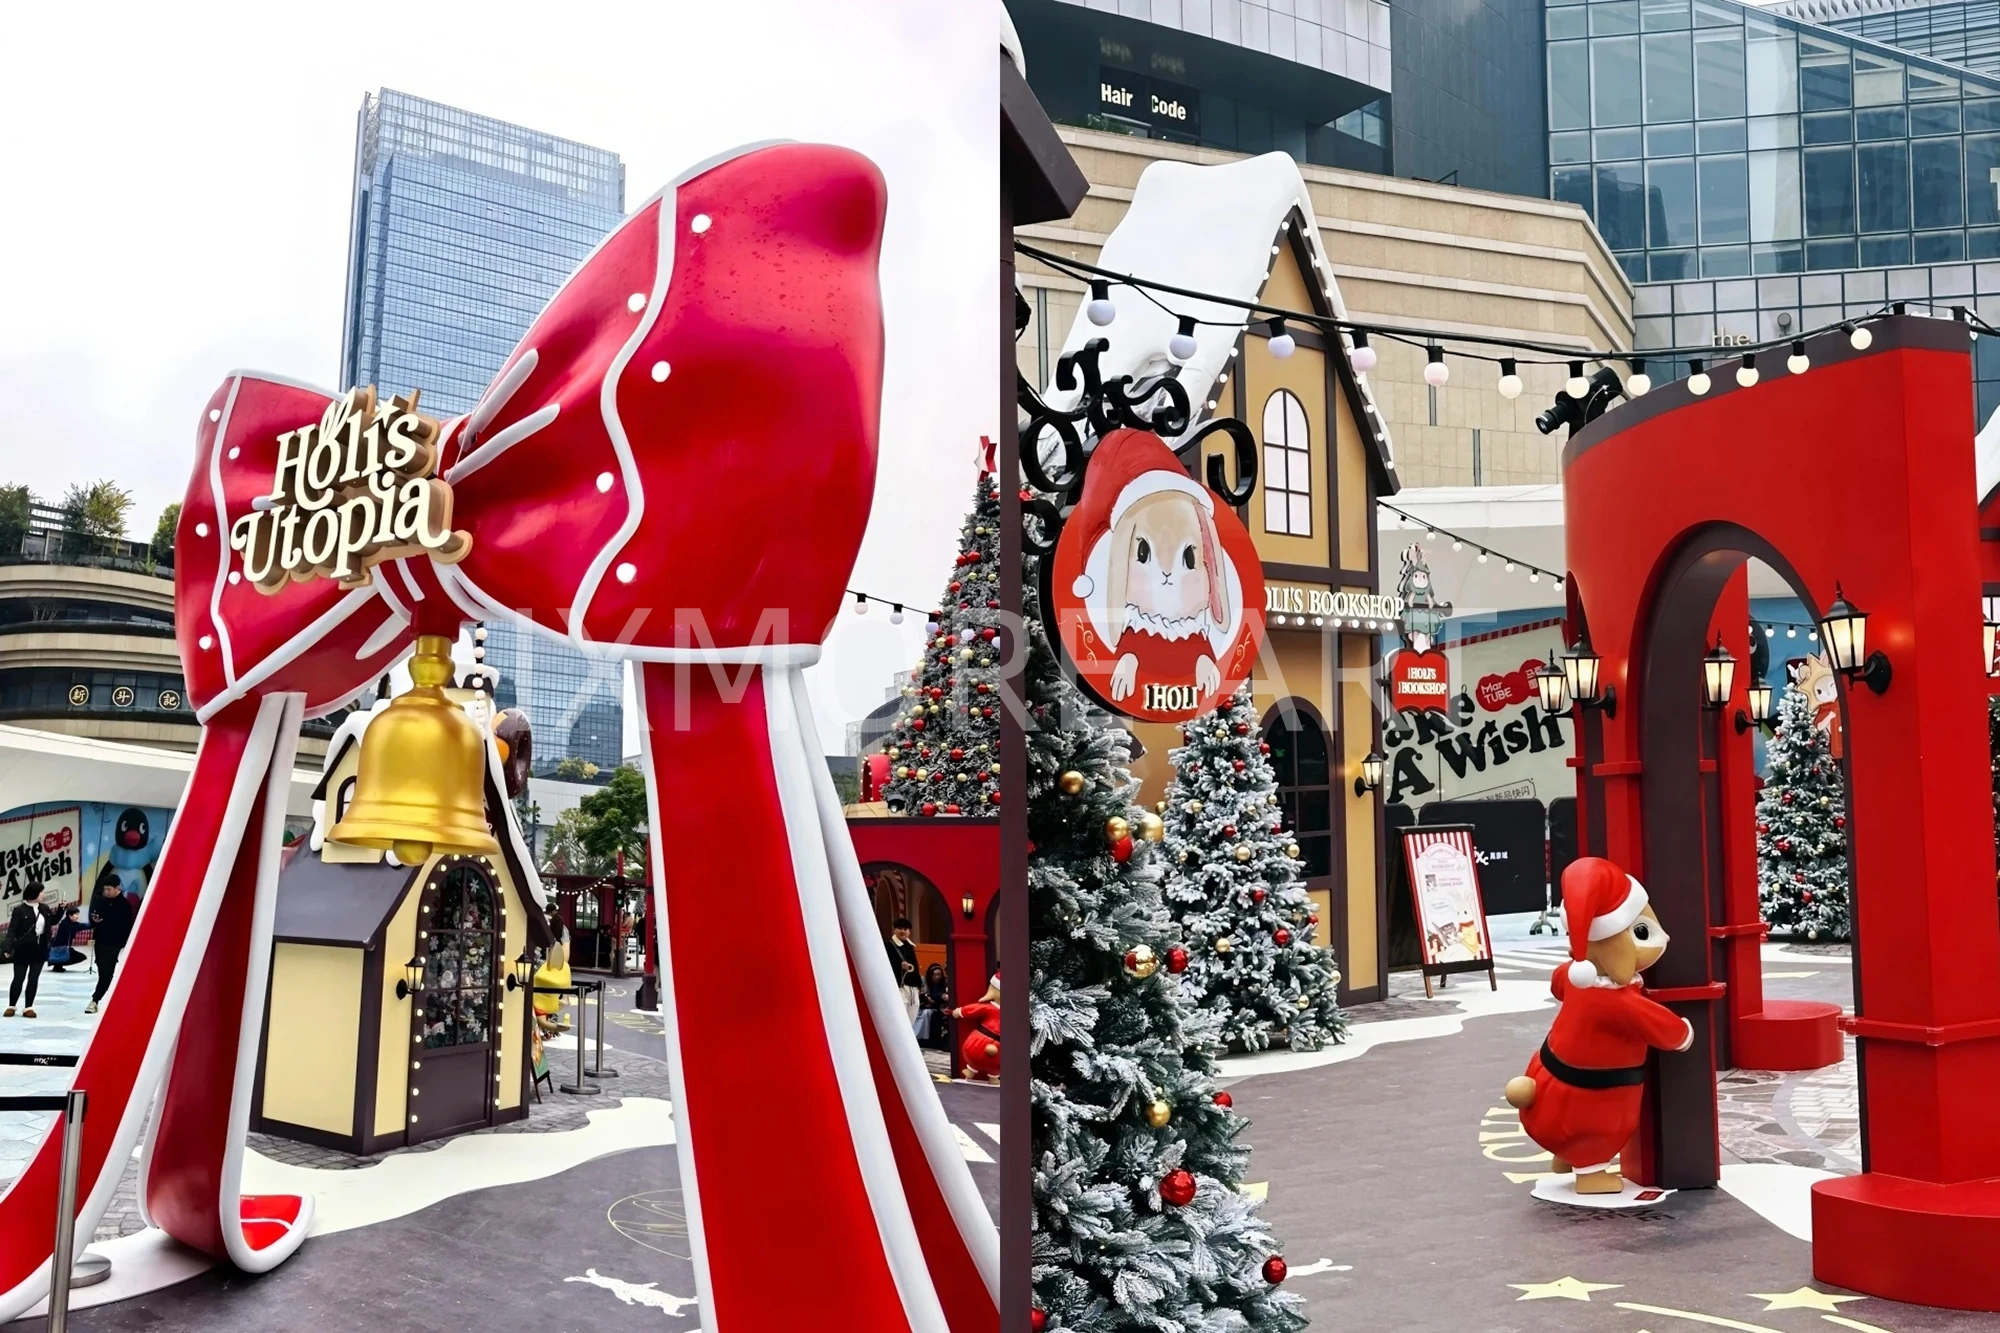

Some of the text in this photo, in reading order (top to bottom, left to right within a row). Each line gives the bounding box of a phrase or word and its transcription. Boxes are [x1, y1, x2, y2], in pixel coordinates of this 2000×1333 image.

[1101, 83, 1187, 120] Hair Code
[1711, 326, 1751, 347] the
[231, 471, 450, 582] Utopia
[1309, 589, 1405, 619] BOOKSHOP
[1409, 666, 1437, 680] HOLI'S
[1150, 685, 1199, 710] HOLI
[1400, 681, 1447, 695] BOOKSHOP
[1481, 682, 1503, 695] Mar
[1484, 687, 1513, 704] TUBE
[1383, 693, 1476, 749] ake
[1386, 705, 1566, 803] A Wish
[3, 850, 72, 899] A Wish
